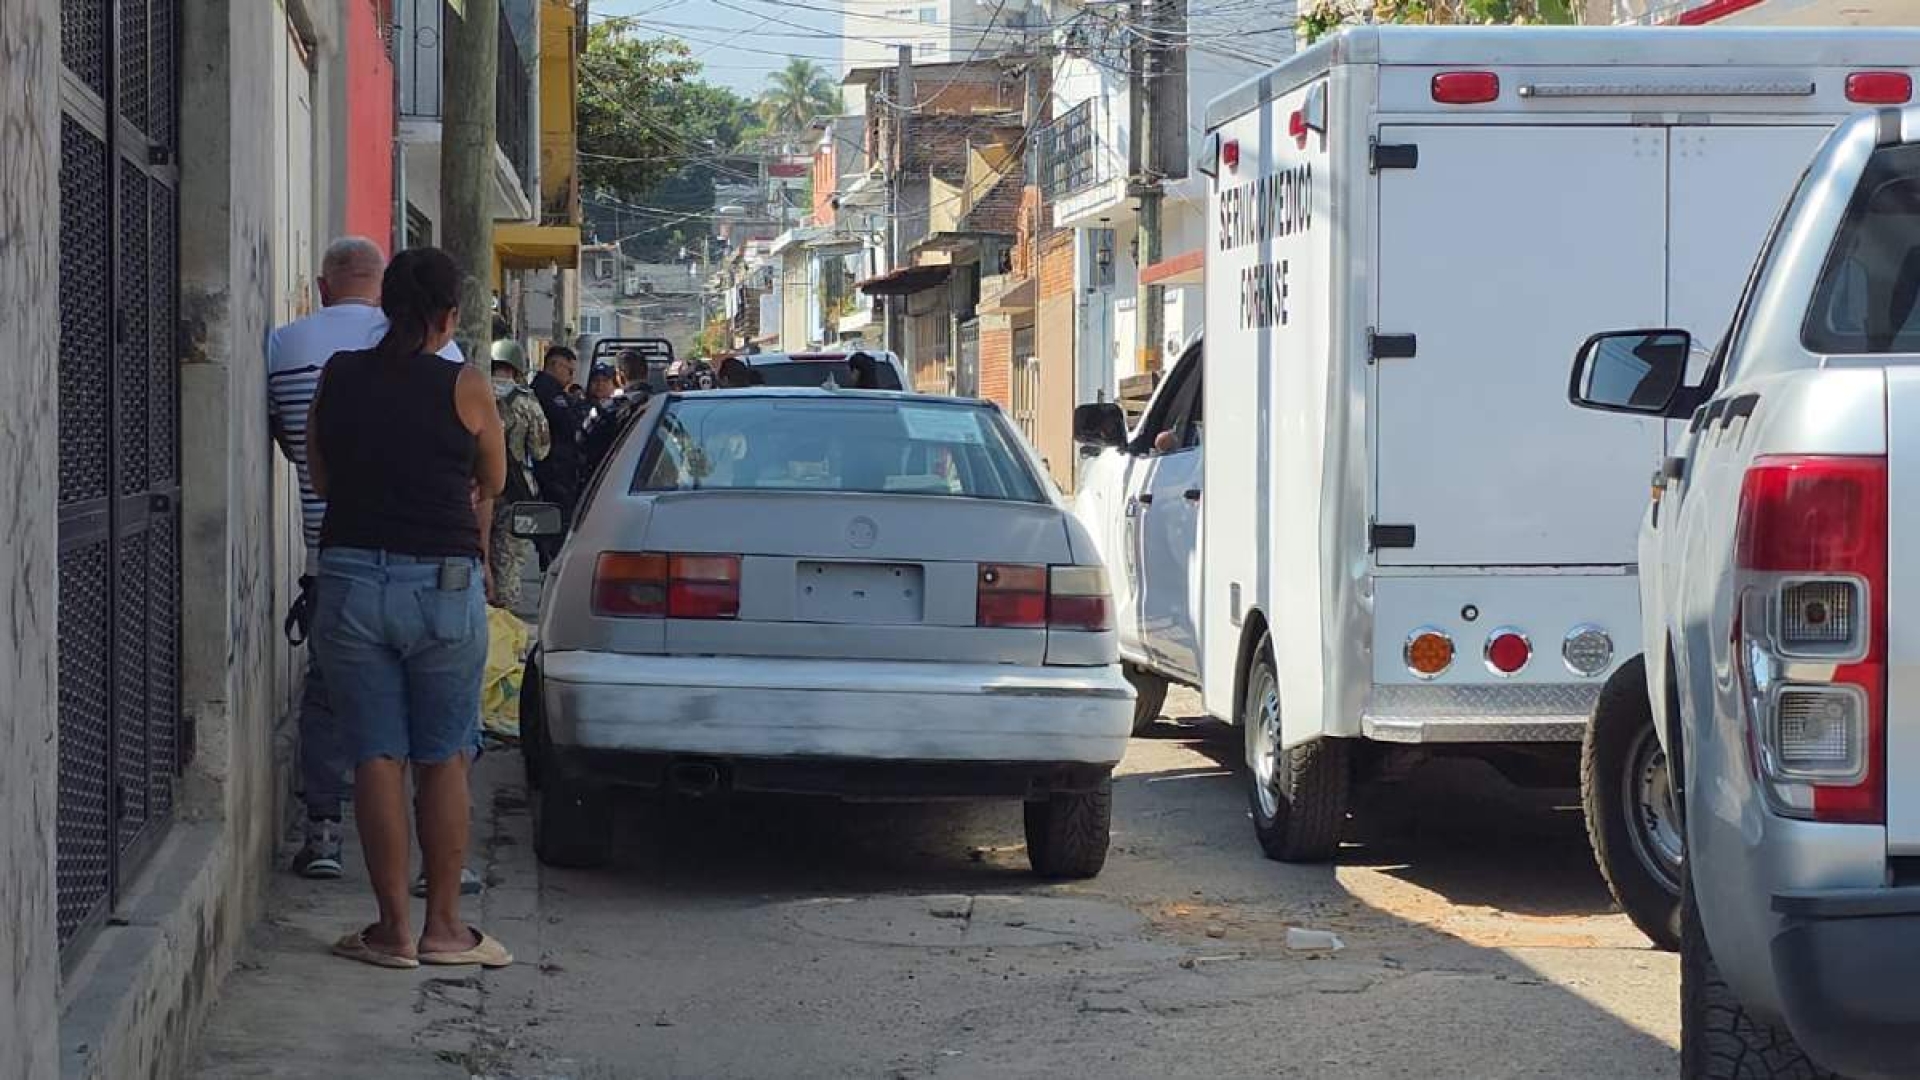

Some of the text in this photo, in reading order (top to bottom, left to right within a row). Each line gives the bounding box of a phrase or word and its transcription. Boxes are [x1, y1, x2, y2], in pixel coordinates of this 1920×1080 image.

[1220, 163, 1312, 251] SERVICIO MEDICO
[1240, 260, 1288, 329] FORENSE
